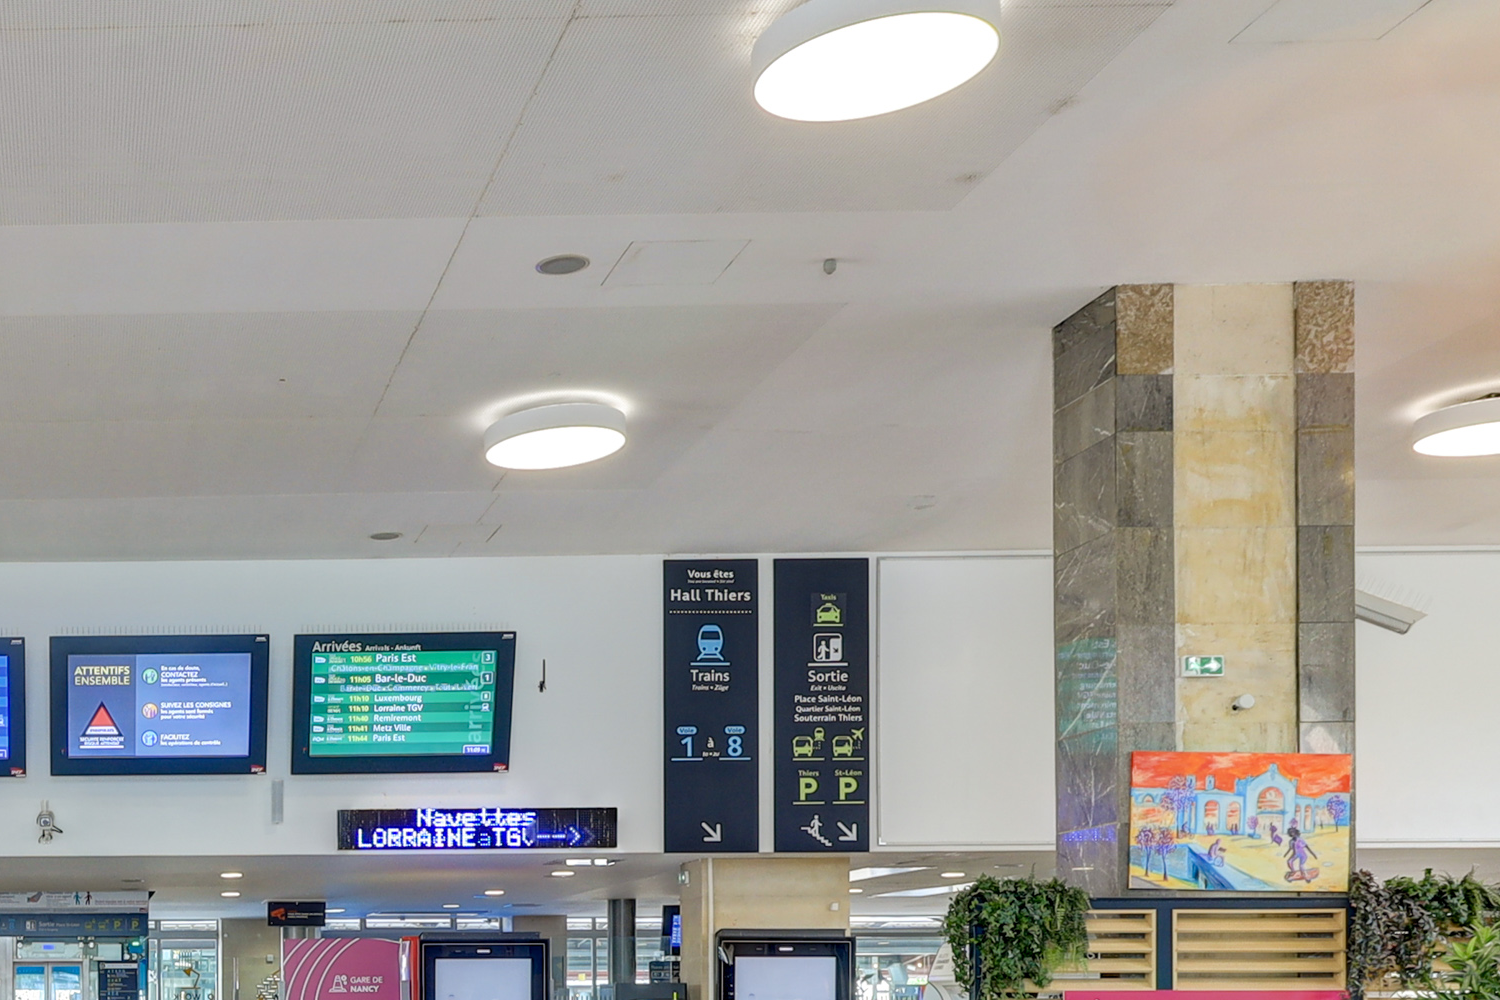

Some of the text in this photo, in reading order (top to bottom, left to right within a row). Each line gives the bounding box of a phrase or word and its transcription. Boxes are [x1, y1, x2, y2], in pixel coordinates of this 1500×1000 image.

[687, 570, 734, 579] Vous êtes
[671, 589, 752, 601] Hall Thiers
[312, 641, 362, 652] Arrivées
[376, 654, 399, 663] Paris
[401, 654, 416, 662] Est
[74, 666, 130, 675] ATTENTIFS
[375, 674, 426, 683] Bar-le-Duc
[690, 669, 730, 682] Trains
[808, 670, 849, 682] Sortie
[74, 677, 130, 685] ENSEMBLE
[713, 684, 729, 692] Züge
[374, 694, 422, 703] Luxembourg
[795, 694, 862, 703] Place Saint-Léon
[374, 704, 405, 712] Lorraine
[796, 705, 861, 713] Quartier Saint-Léon
[374, 714, 422, 722] Remiremont
[794, 714, 863, 722] Souterrain Thiers
[373, 724, 392, 732] Metz
[394, 724, 411, 732] Ville
[373, 734, 392, 742] Paris
[681, 737, 693, 757] 1
[727, 736, 742, 757] 8
[798, 769, 862, 777] Thiers St-Léon
[800, 777, 858, 800] P P
[417, 807, 536, 827] Navettes
[357, 828, 476, 848] LORRAINE
